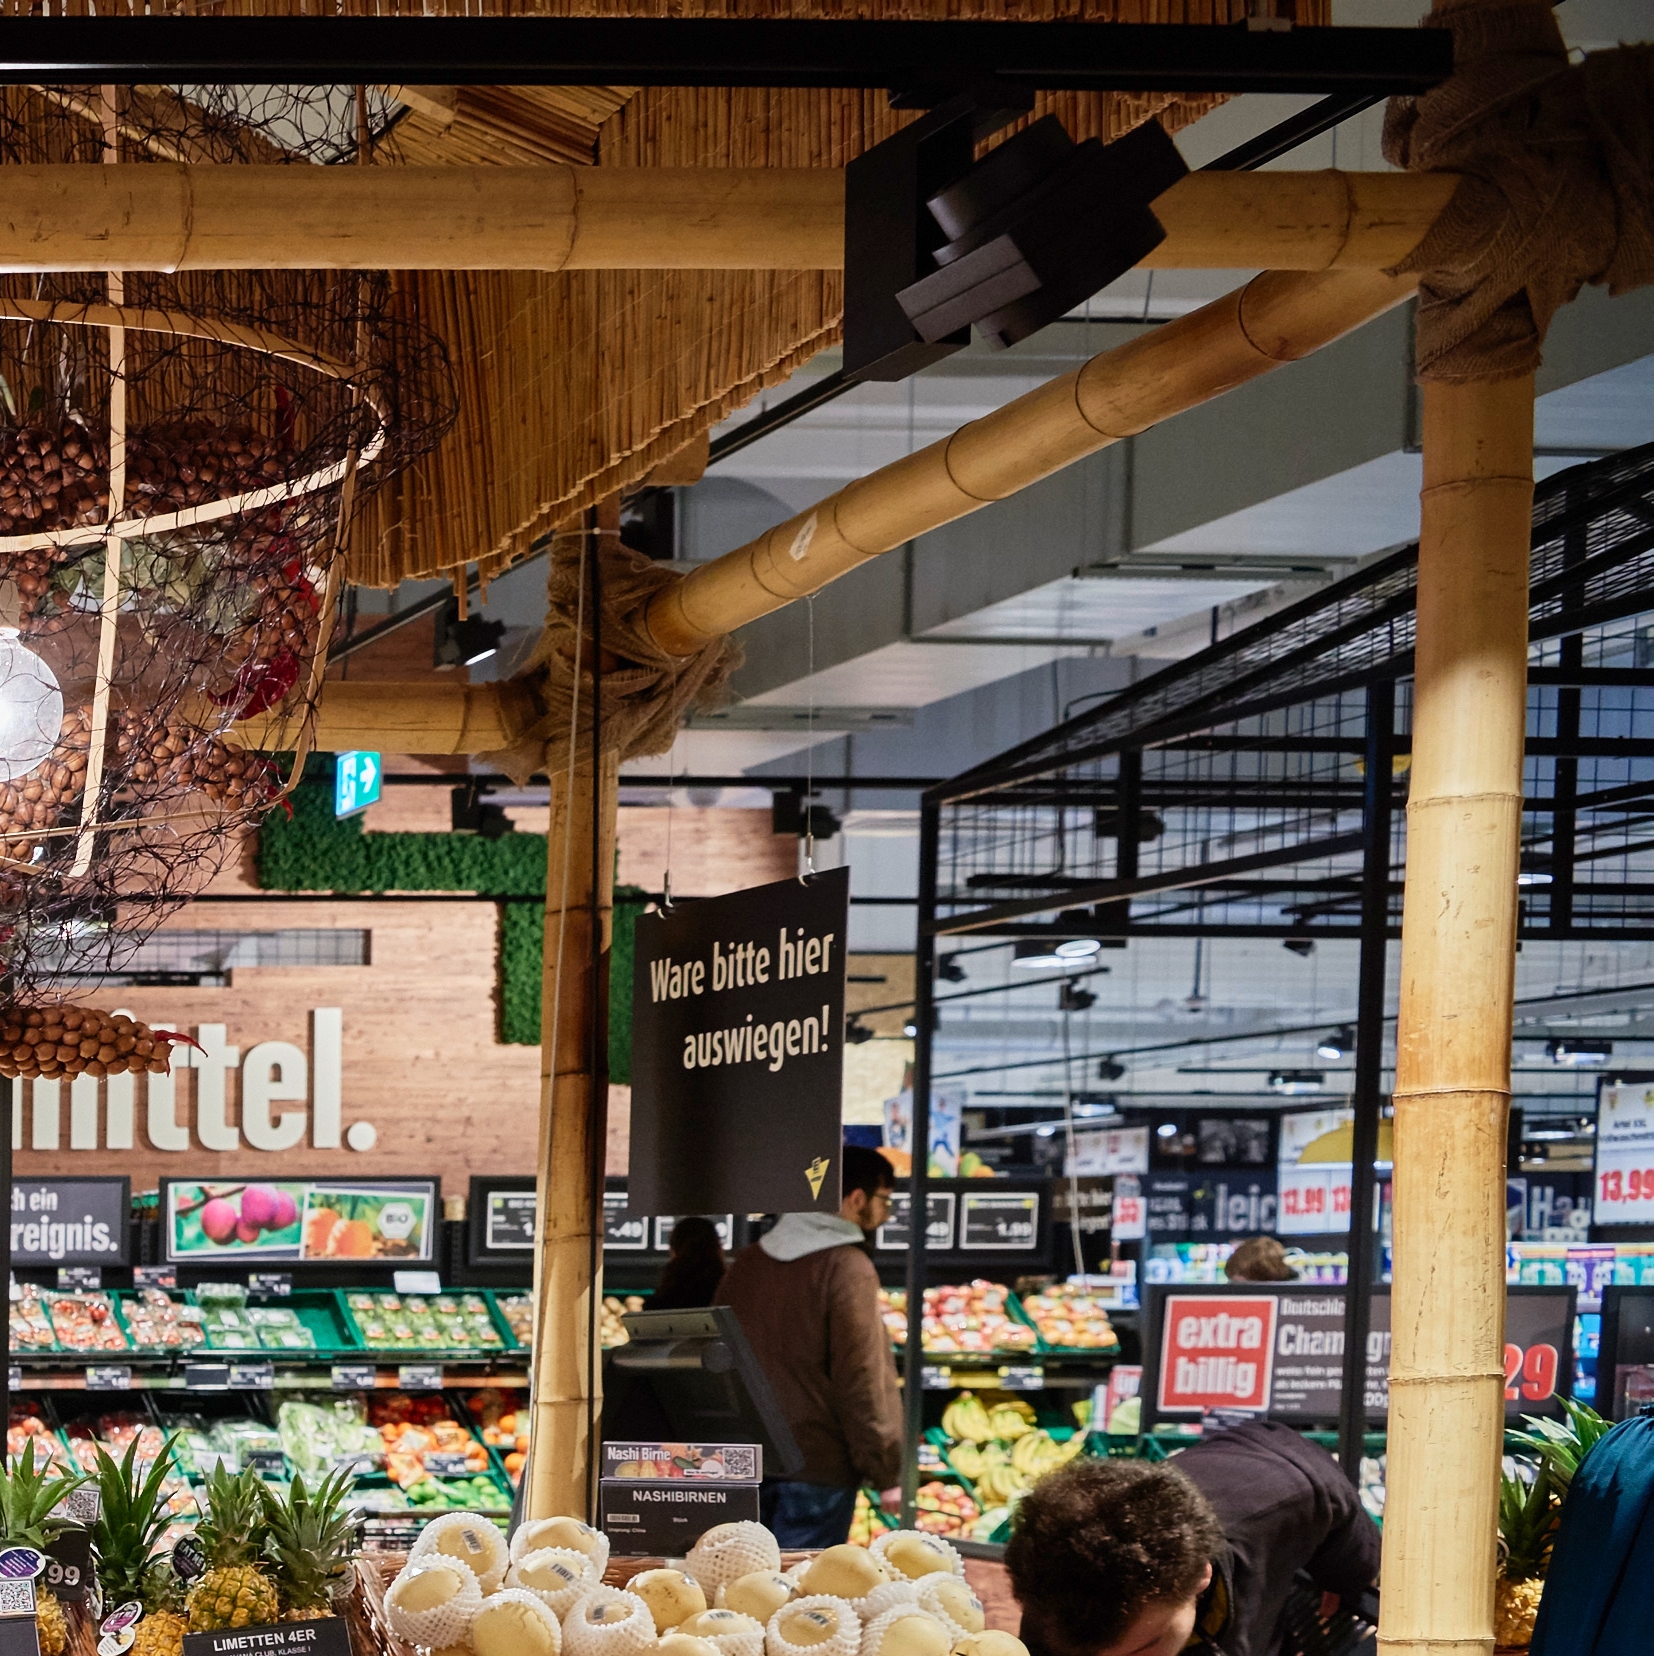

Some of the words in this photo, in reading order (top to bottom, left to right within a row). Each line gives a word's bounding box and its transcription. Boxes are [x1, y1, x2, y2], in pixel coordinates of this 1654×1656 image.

[651, 958, 704, 1002] Ware
[713, 941, 770, 992] bitte
[779, 928, 834, 981] hier
[684, 1005, 830, 1072] auswiegen!
[29, 1188, 58, 1211] ein
[1177, 1313, 1263, 1349] extra
[1173, 1357, 1257, 1398] billig
[607, 1446, 638, 1462] Nashi
[641, 1447, 671, 1462] Birne
[632, 1490, 727, 1504] NASHIBIRNEN
[214, 1633, 284, 1652] LIMETTEN
[288, 1628, 316, 1643] 4ER
[278, 1648, 307, 1656] KLASSE
